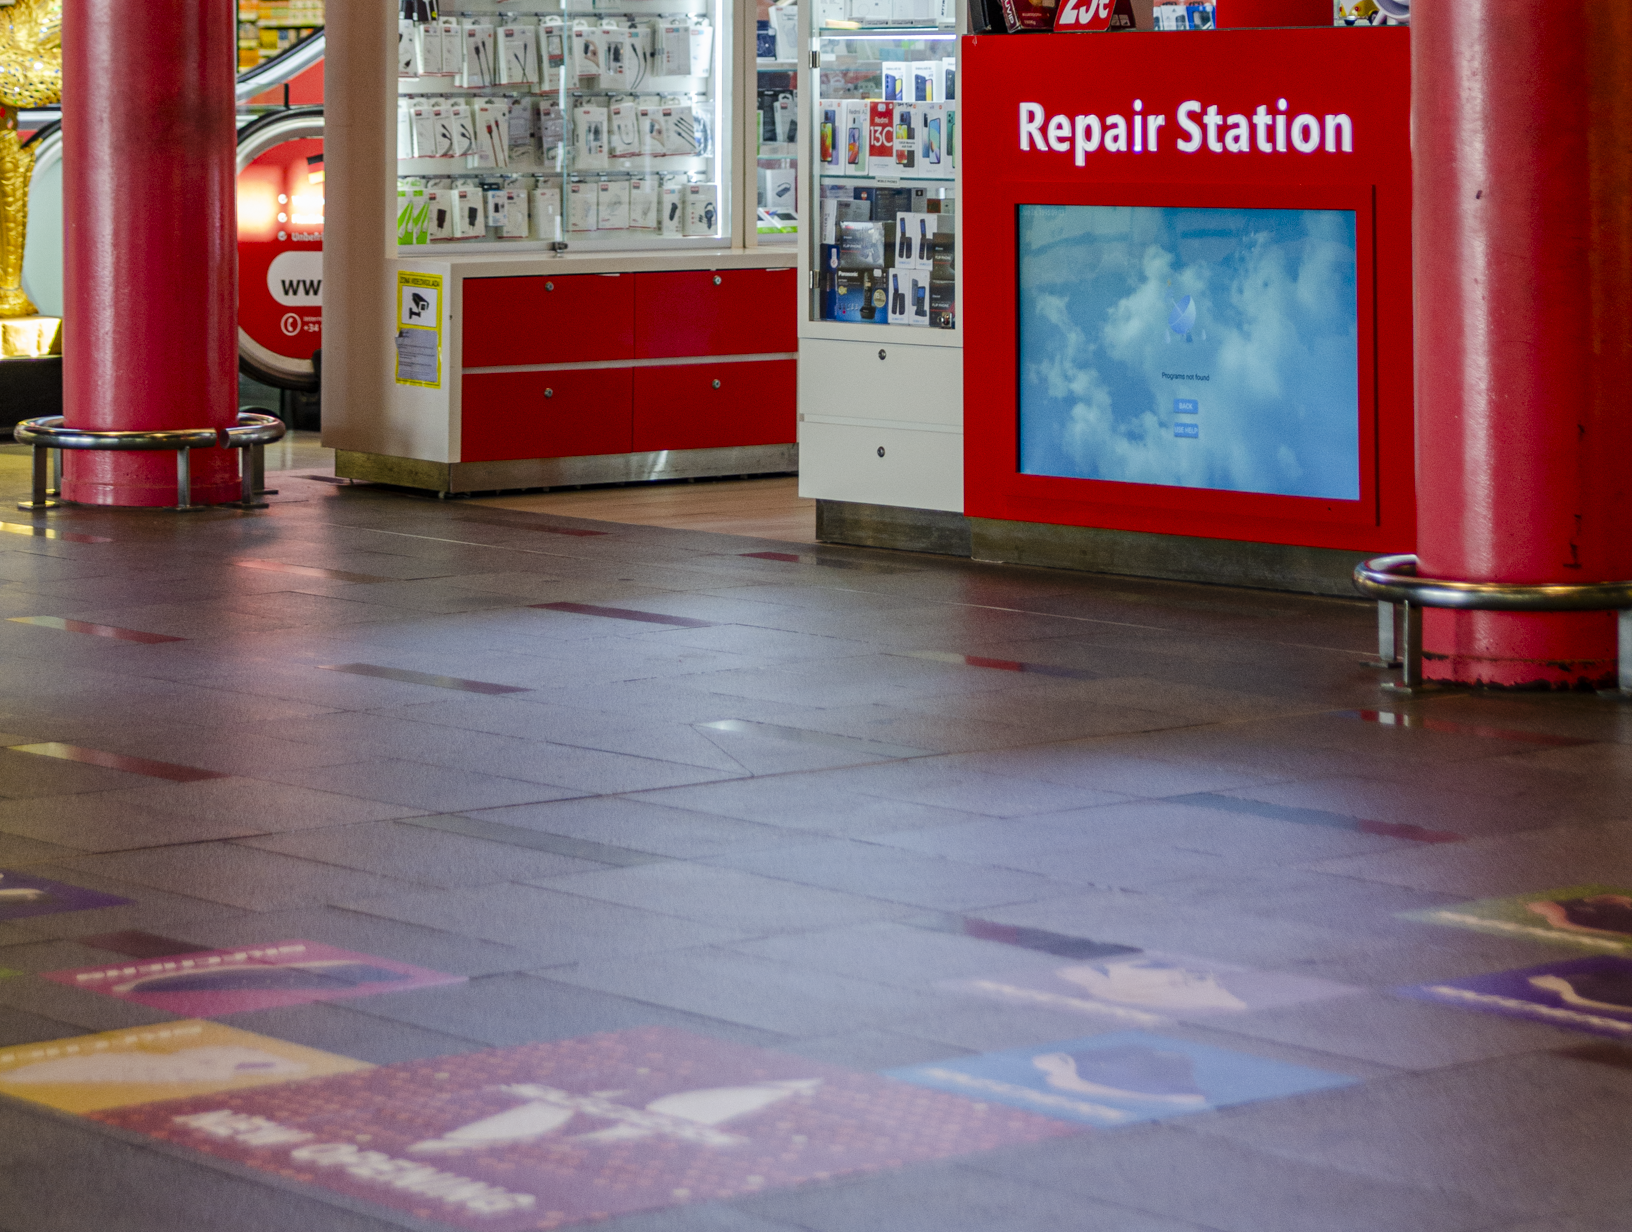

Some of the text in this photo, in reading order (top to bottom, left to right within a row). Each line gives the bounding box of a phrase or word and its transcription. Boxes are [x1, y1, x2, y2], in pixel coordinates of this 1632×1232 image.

[869, 126, 893, 147] 13C
[1018, 97, 1353, 167] Repair Station
[1161, 372, 1185, 381] Programs
[1195, 373, 1210, 381] found
